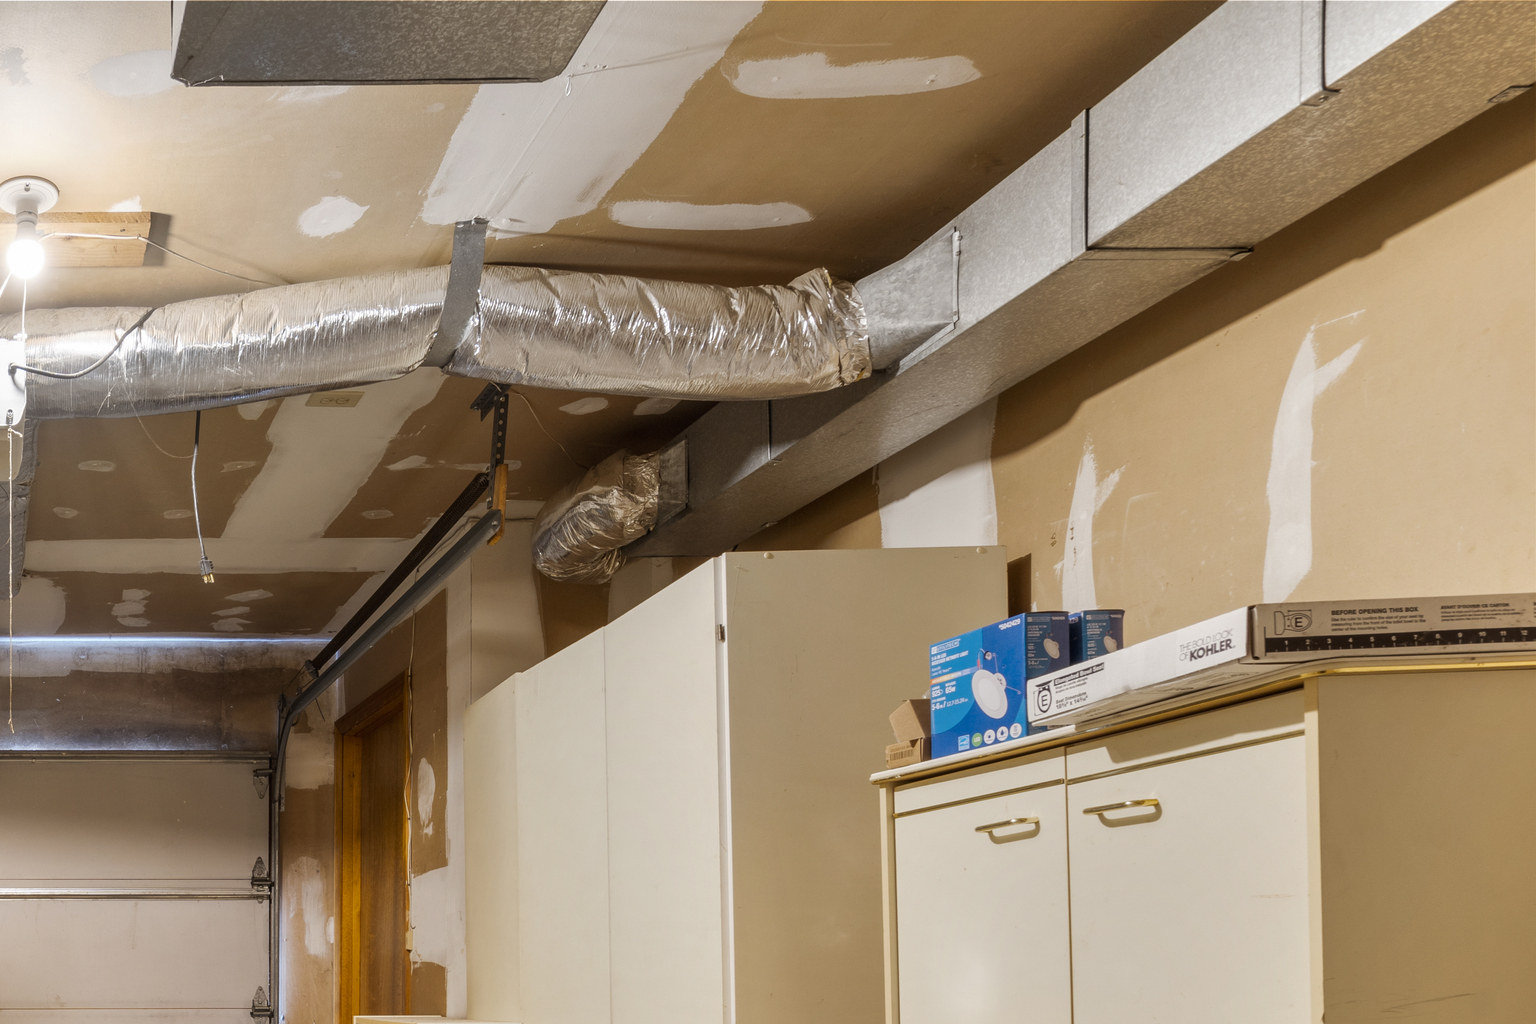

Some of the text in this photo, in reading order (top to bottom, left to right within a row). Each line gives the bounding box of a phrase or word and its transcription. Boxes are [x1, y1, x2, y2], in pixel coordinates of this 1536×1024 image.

[1295, 617, 1303, 628] E
[1179, 628, 1233, 652] THE BOLD LOOK
[1179, 638, 1233, 662] OF KOHLER
[1041, 694, 1048, 707] E
